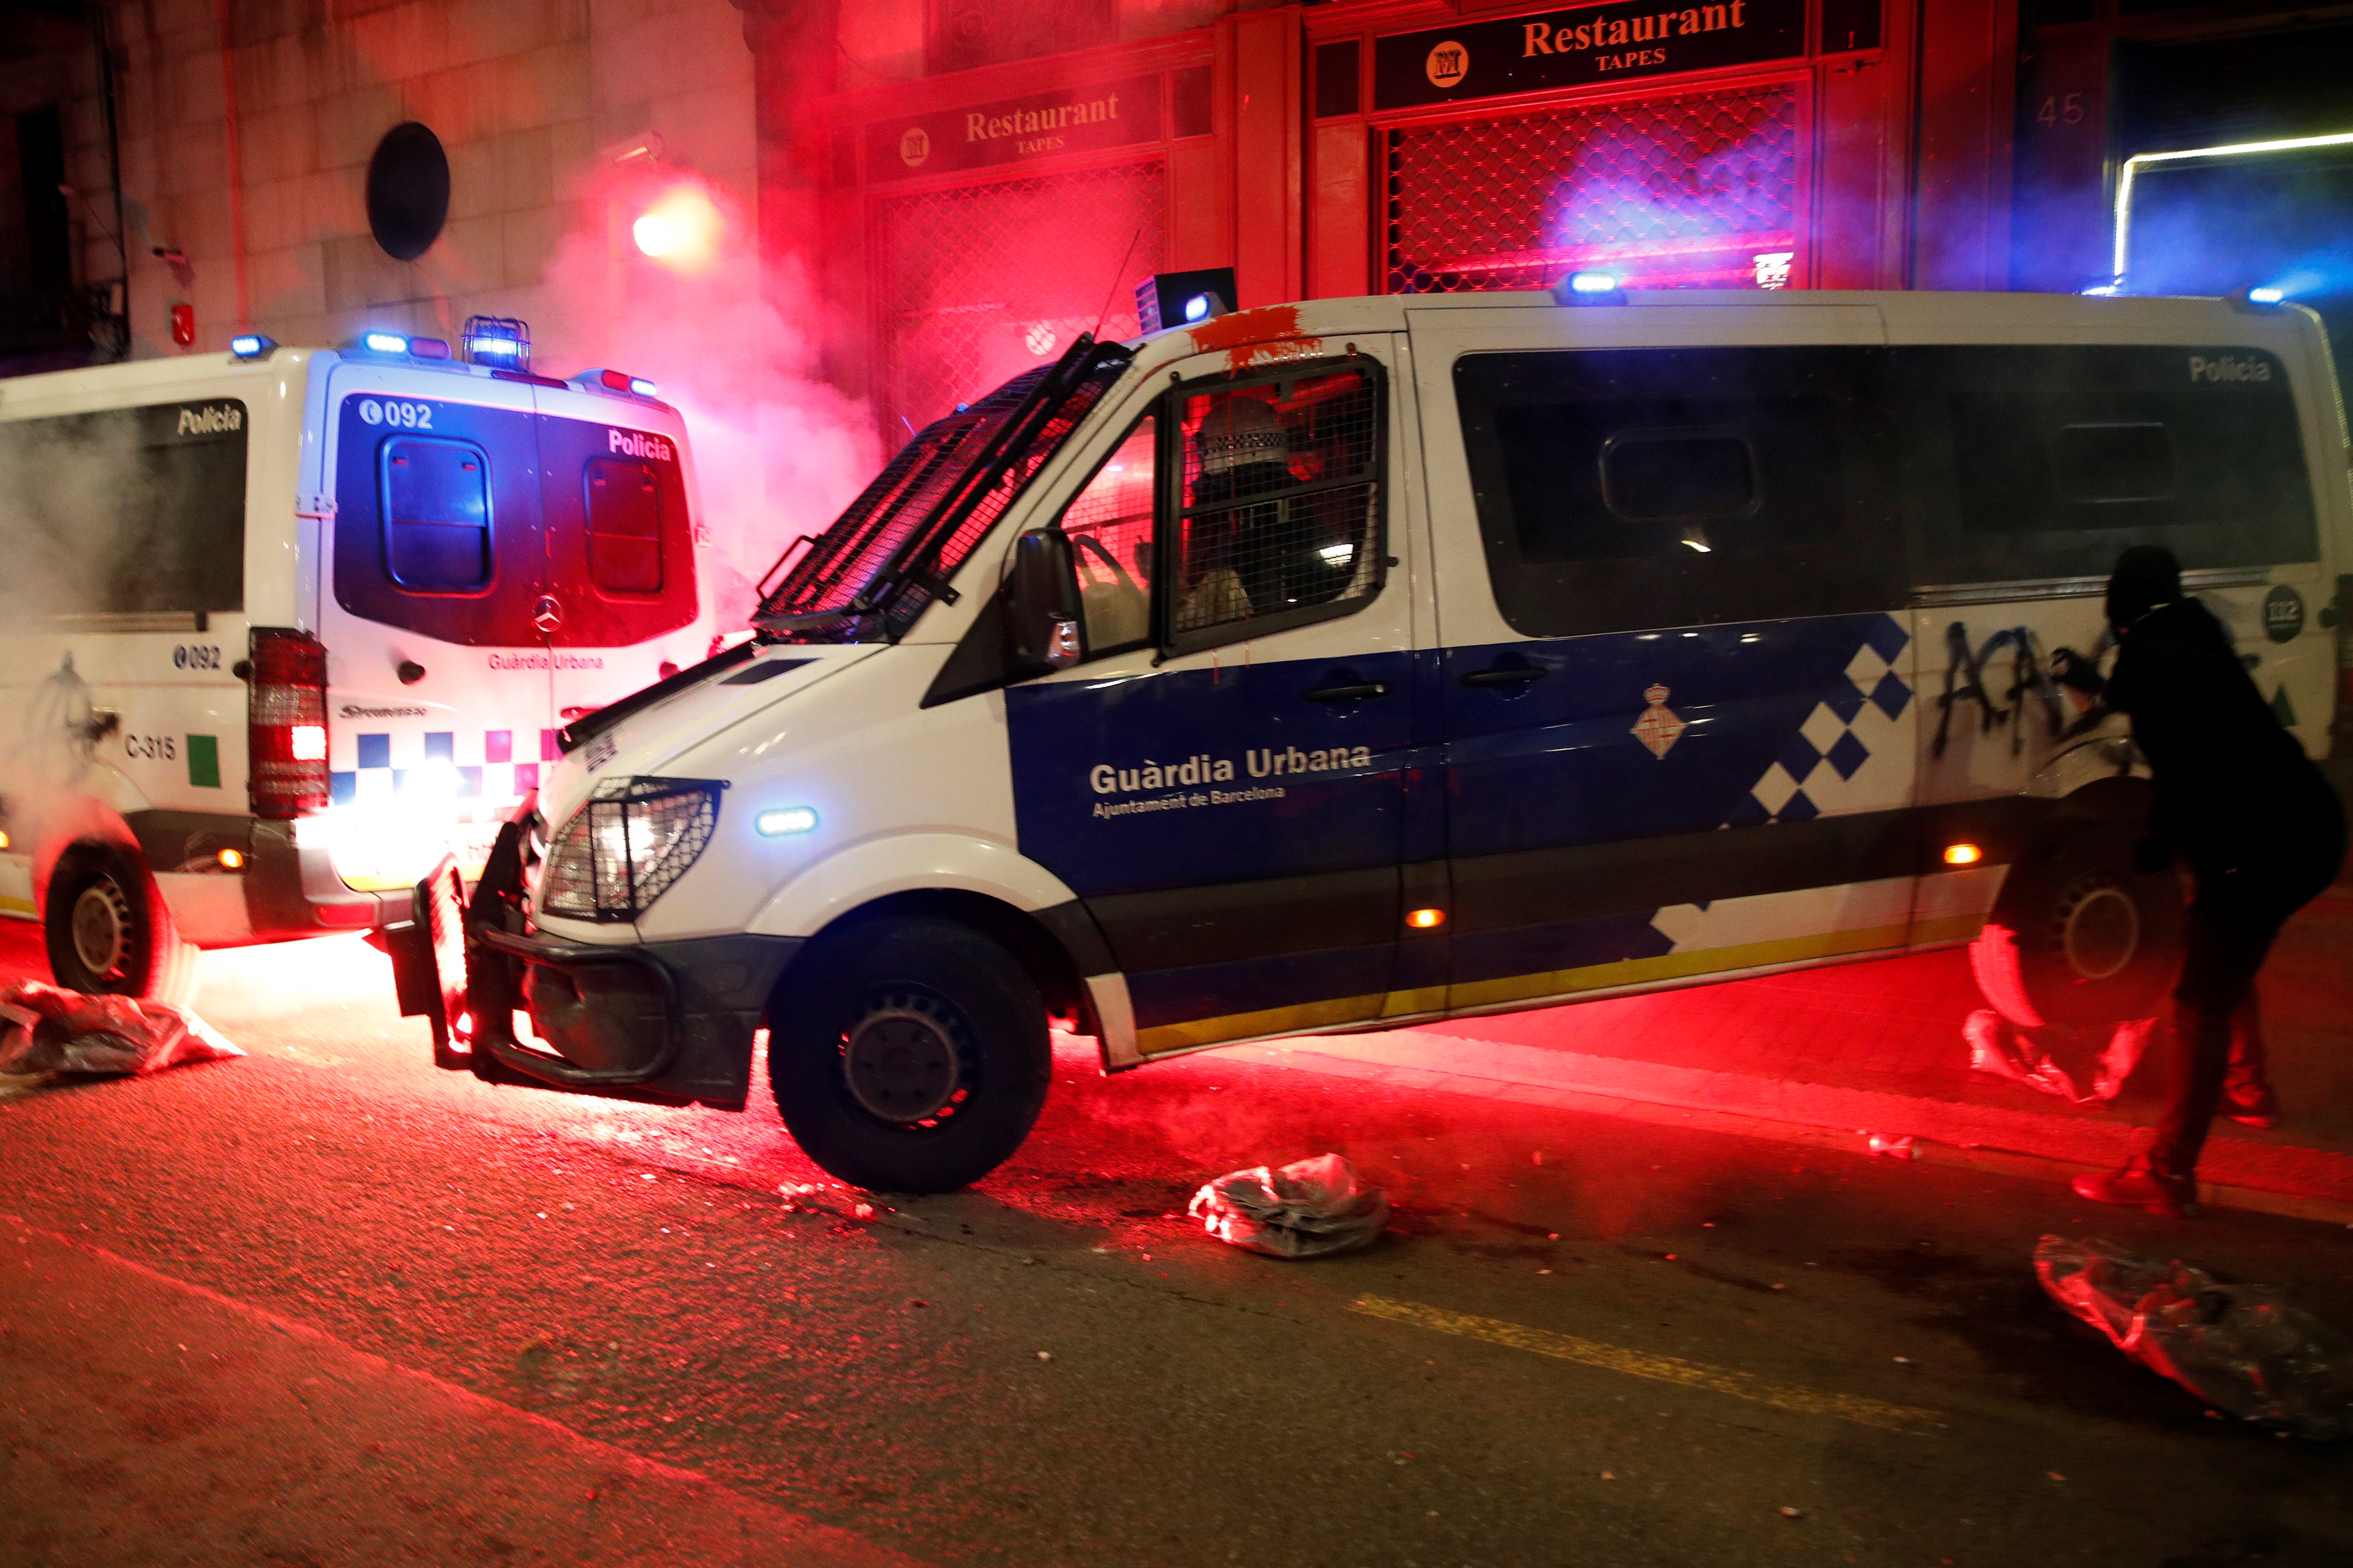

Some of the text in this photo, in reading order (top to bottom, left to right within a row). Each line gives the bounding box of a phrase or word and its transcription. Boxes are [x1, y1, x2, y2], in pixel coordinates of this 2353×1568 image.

[1522, 0, 1746, 57] Restaurant
[1595, 47, 1667, 72] TAPES
[966, 91, 1118, 143] Restaurant
[2036, 92, 2085, 128] 45
[1016, 136, 1065, 155] TAPES
[386, 402, 433, 429] 092
[609, 428, 672, 462] Policia
[189, 645, 222, 671] 092
[488, 653, 604, 671] Guàrdia Urbana
[126, 734, 176, 760] C-315
[1090, 745, 1372, 795] Guàrdia Urbana
[1093, 785, 1286, 819] Ajuntament de Barcelona
